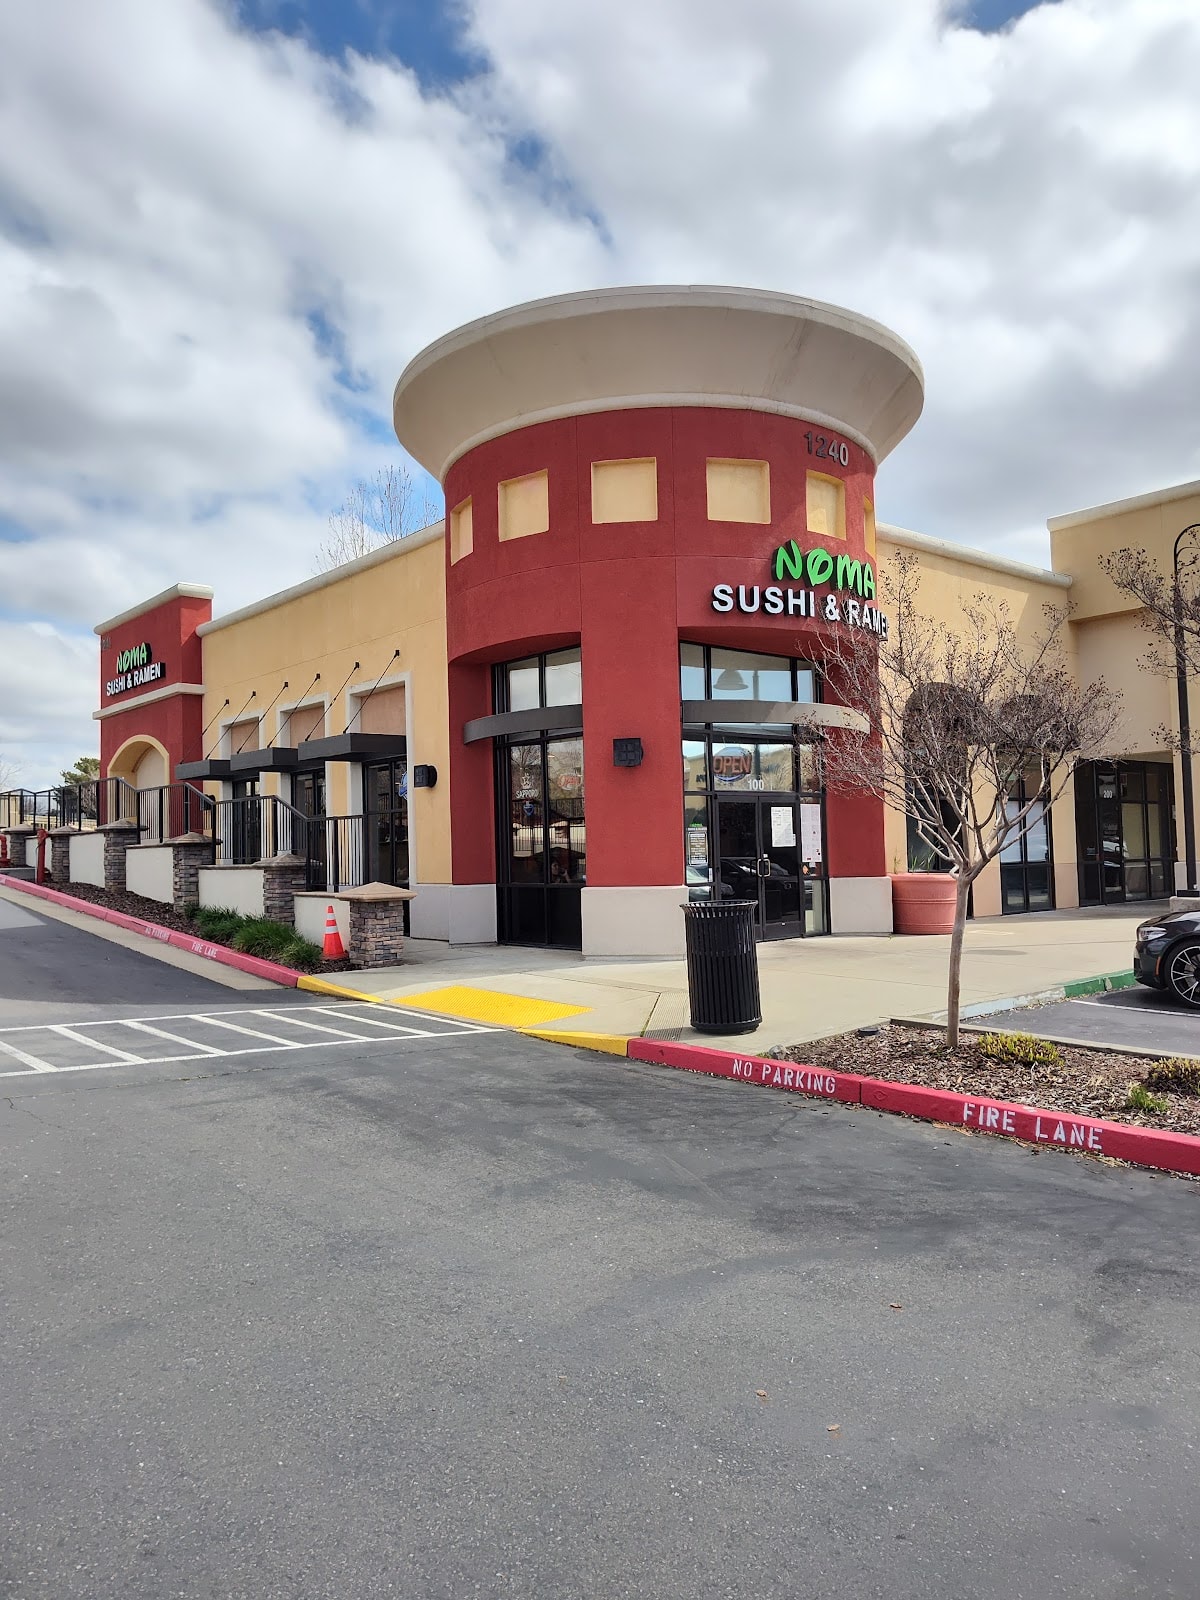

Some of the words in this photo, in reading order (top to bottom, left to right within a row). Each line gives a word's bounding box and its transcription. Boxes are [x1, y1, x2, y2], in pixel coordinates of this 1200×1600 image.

[803, 431, 849, 467] 1240
[773, 539, 877, 601] NOMA
[711, 583, 816, 618] SUSHI
[825, 593, 841, 622] &
[116, 641, 148, 675] NOMA
[106, 675, 126, 696] SUSHI
[126, 672, 132, 689] &
[133, 661, 161, 687] RAMEN
[713, 756, 751, 775] OPEN
[747, 779, 765, 791] 100
[192, 942, 204, 952] FIRE
[204, 945, 218, 958] LANE
[732, 1058, 753, 1078] NO
[761, 1063, 837, 1094] PARKING
[963, 1102, 1016, 1132] FIRE
[1034, 1116, 1103, 1150] LANE
